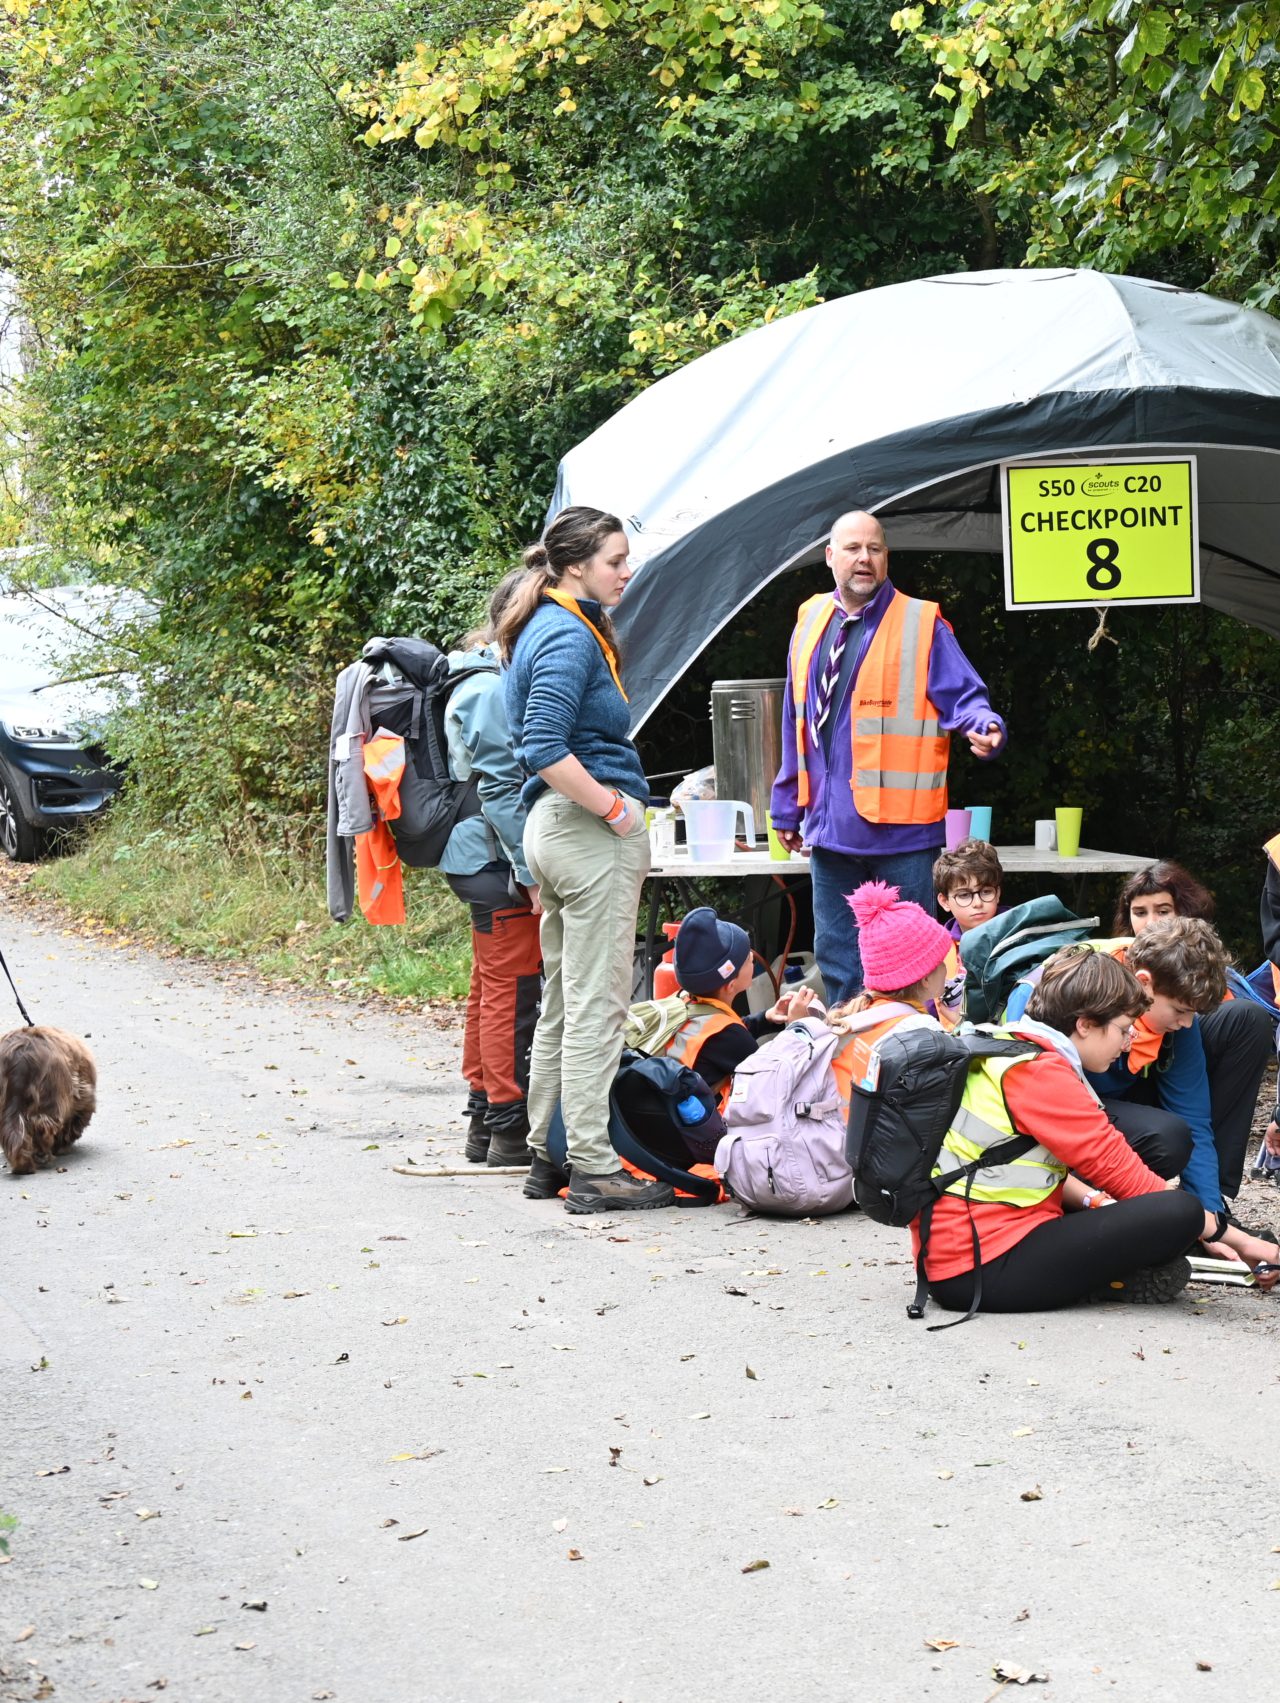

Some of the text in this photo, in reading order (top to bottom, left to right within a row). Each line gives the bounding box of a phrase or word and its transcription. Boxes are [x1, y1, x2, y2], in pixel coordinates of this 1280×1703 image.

[1039, 475, 1162, 497] S50 scouts C20
[1021, 505, 1183, 533] CHECKPOINT
[1086, 538, 1122, 591] 8
